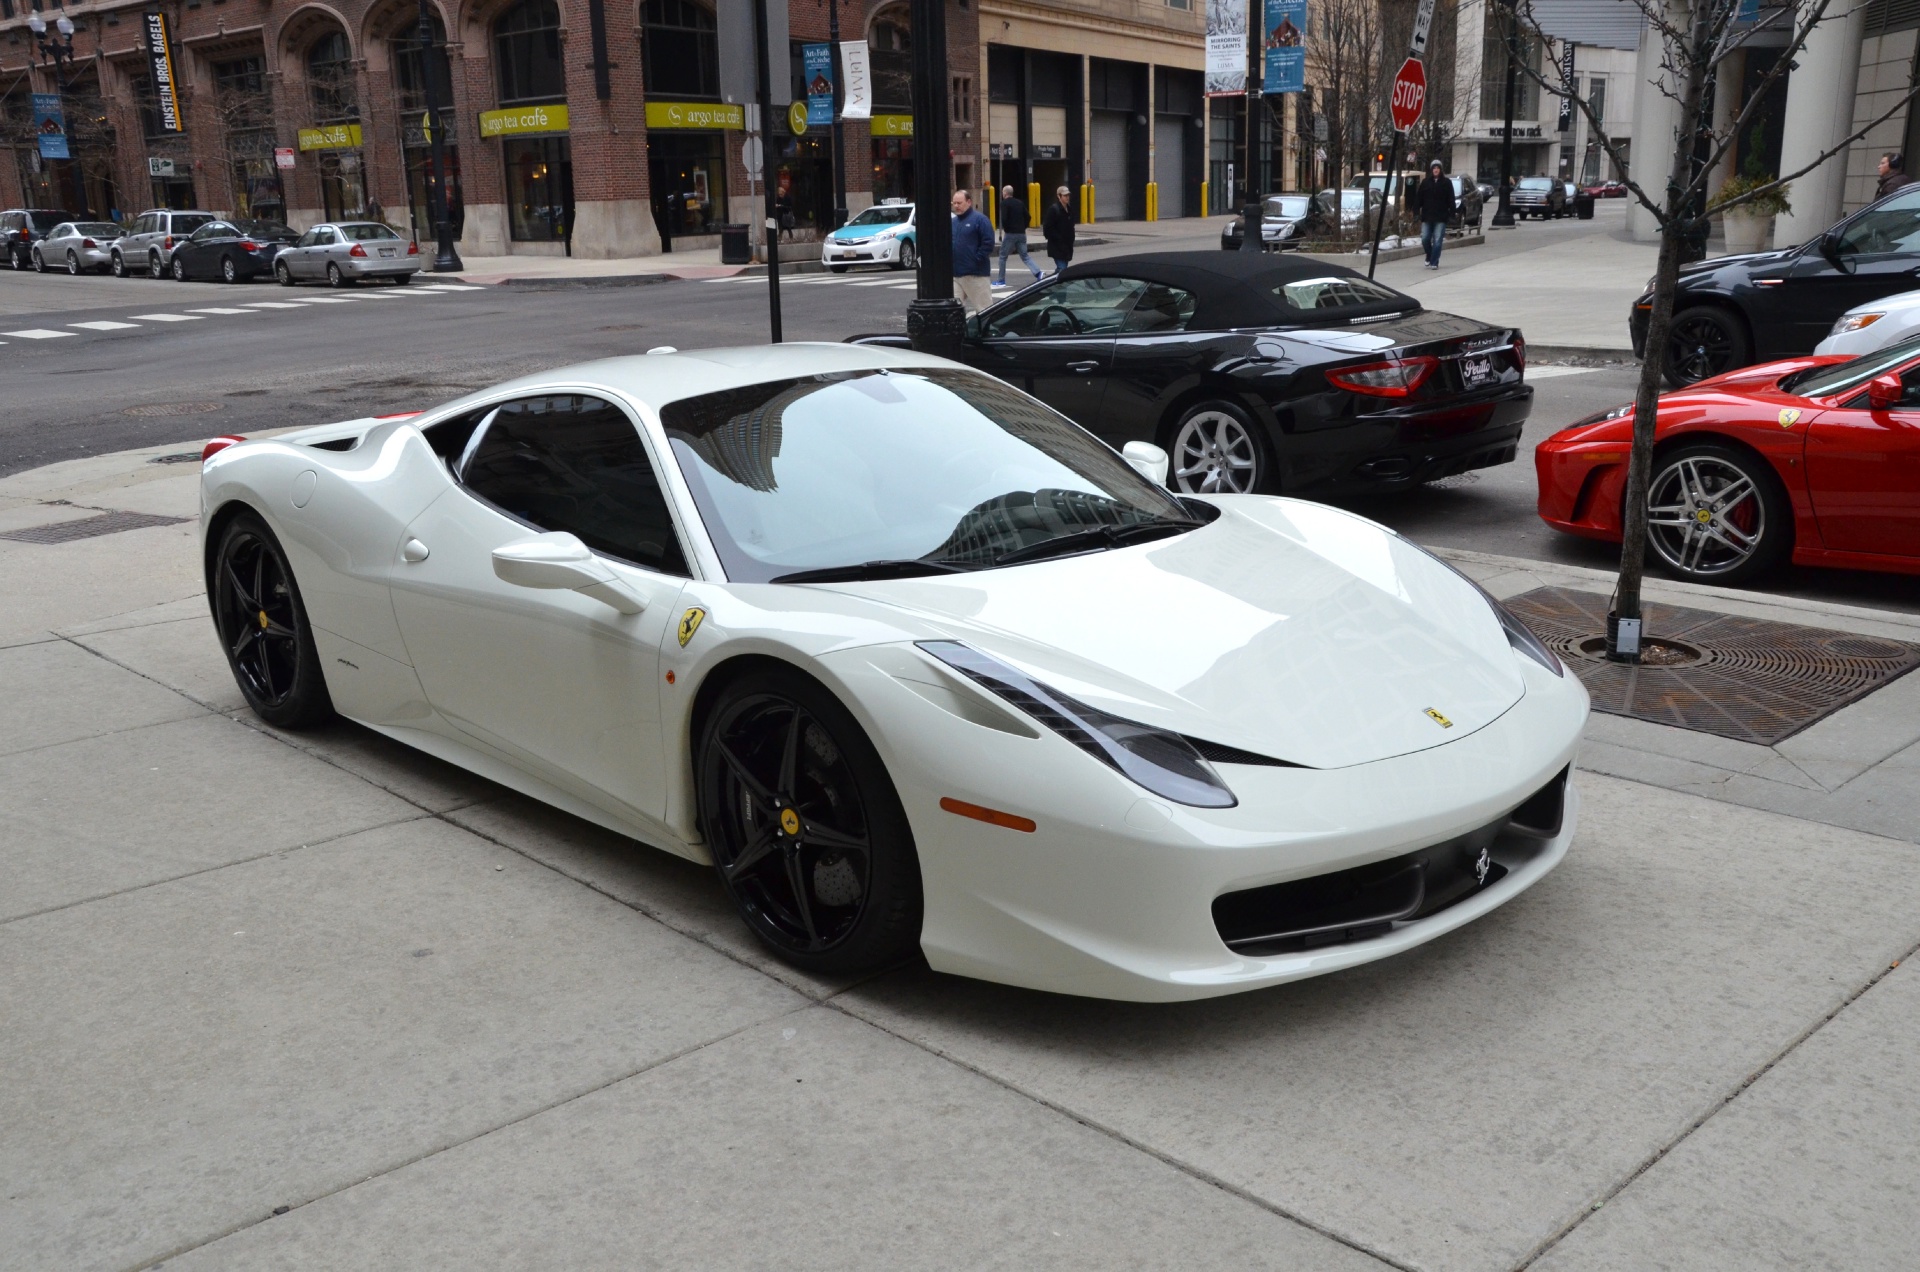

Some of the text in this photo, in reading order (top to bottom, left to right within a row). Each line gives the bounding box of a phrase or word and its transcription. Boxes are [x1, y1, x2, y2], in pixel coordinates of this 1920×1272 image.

[1418, 14, 1430, 30] WAY
[148, 15, 176, 129] EINSTEIN BROS. BAGELS
[1394, 79, 1424, 110] STOP
[1560, 96, 1570, 116] ack
[504, 116, 518, 128] tea
[520, 108, 548, 126] café
[688, 111, 712, 126] argo
[714, 110, 726, 123] tea
[901, 122, 913, 136] arg
[1464, 360, 1490, 378] Perillo
